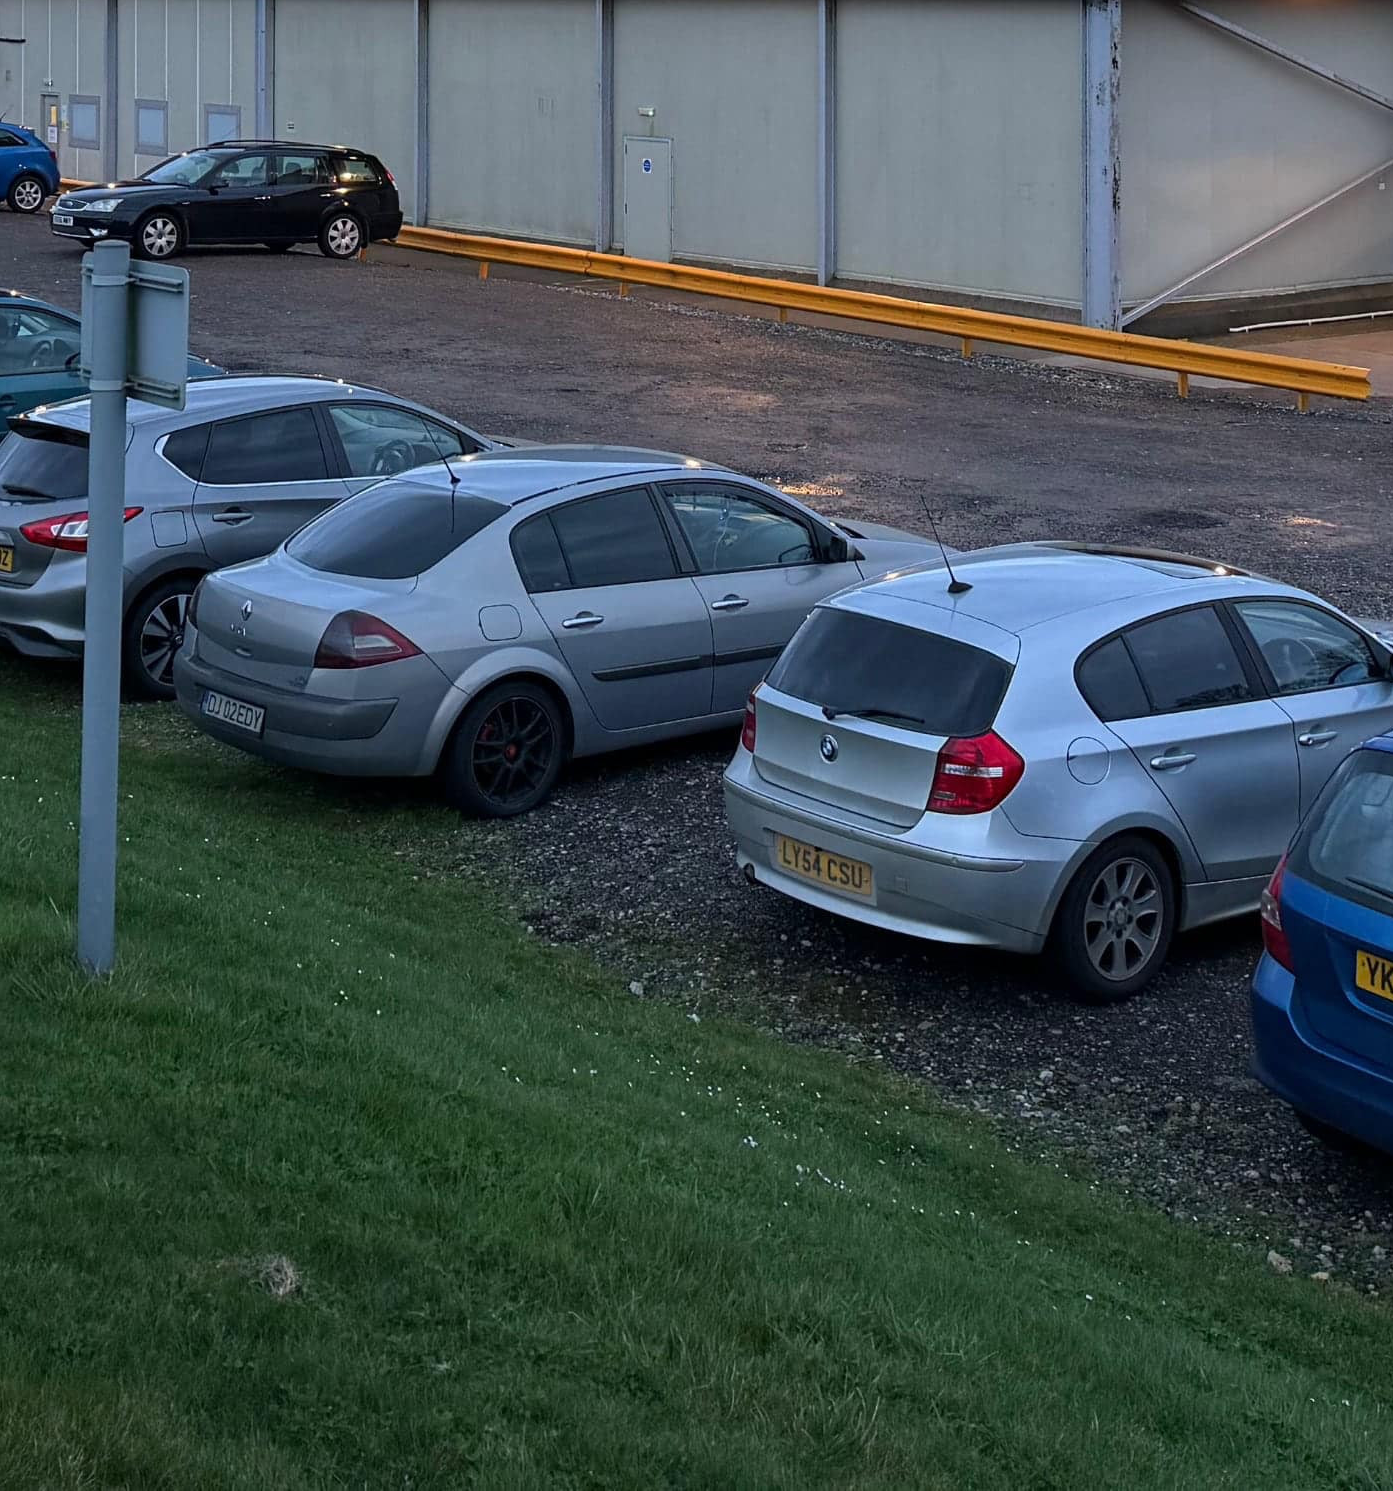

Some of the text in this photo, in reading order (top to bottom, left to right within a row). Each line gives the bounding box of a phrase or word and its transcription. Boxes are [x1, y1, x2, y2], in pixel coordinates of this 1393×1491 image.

[207, 693, 223, 715] DJ
[782, 840, 863, 889] LY54 CSU
